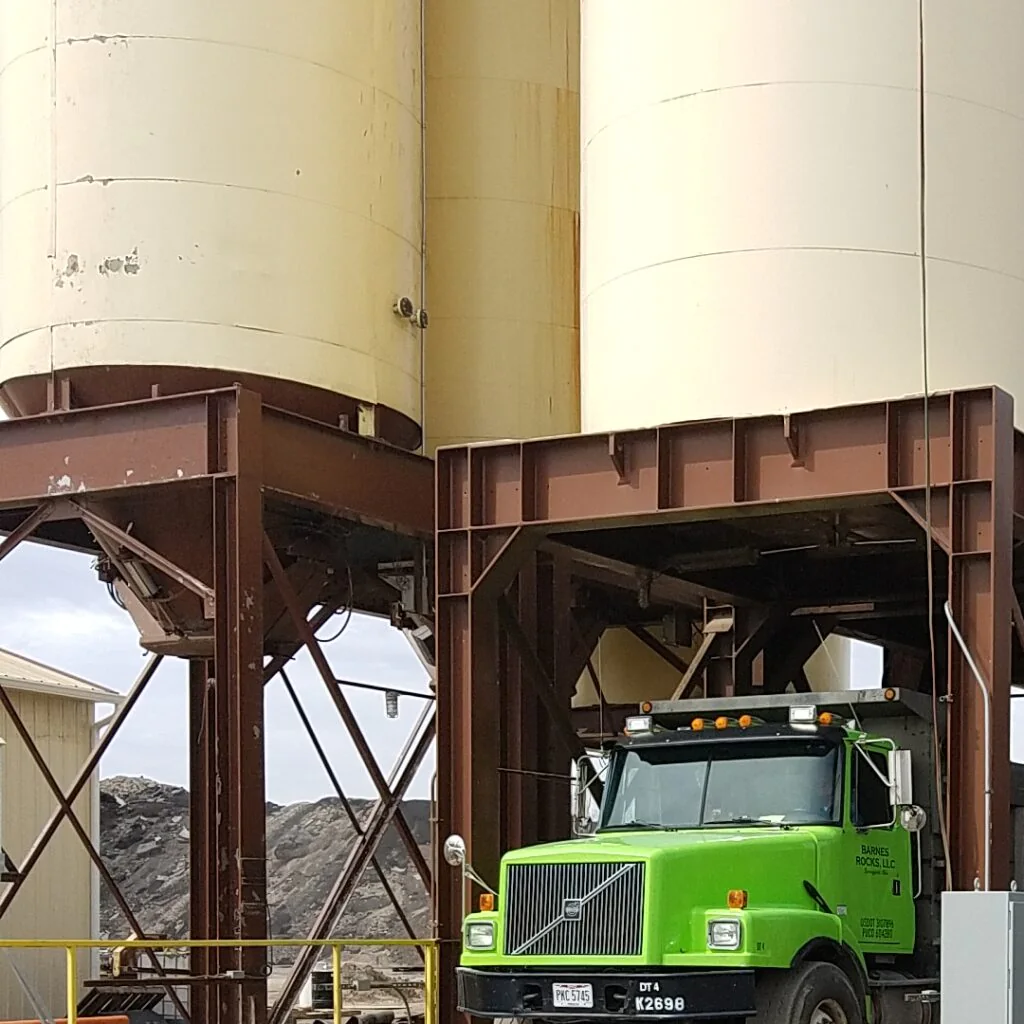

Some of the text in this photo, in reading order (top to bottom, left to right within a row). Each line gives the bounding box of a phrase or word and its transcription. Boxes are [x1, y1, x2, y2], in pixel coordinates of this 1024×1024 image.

[861, 844, 890, 857] BARNES
[855, 856, 896, 869] ROCKS, LLC
[860, 918, 875, 928] USDOT
[639, 981, 660, 992] DT 4
[555, 989, 590, 1002] PKC 5745
[635, 996, 685, 1011] K2698
